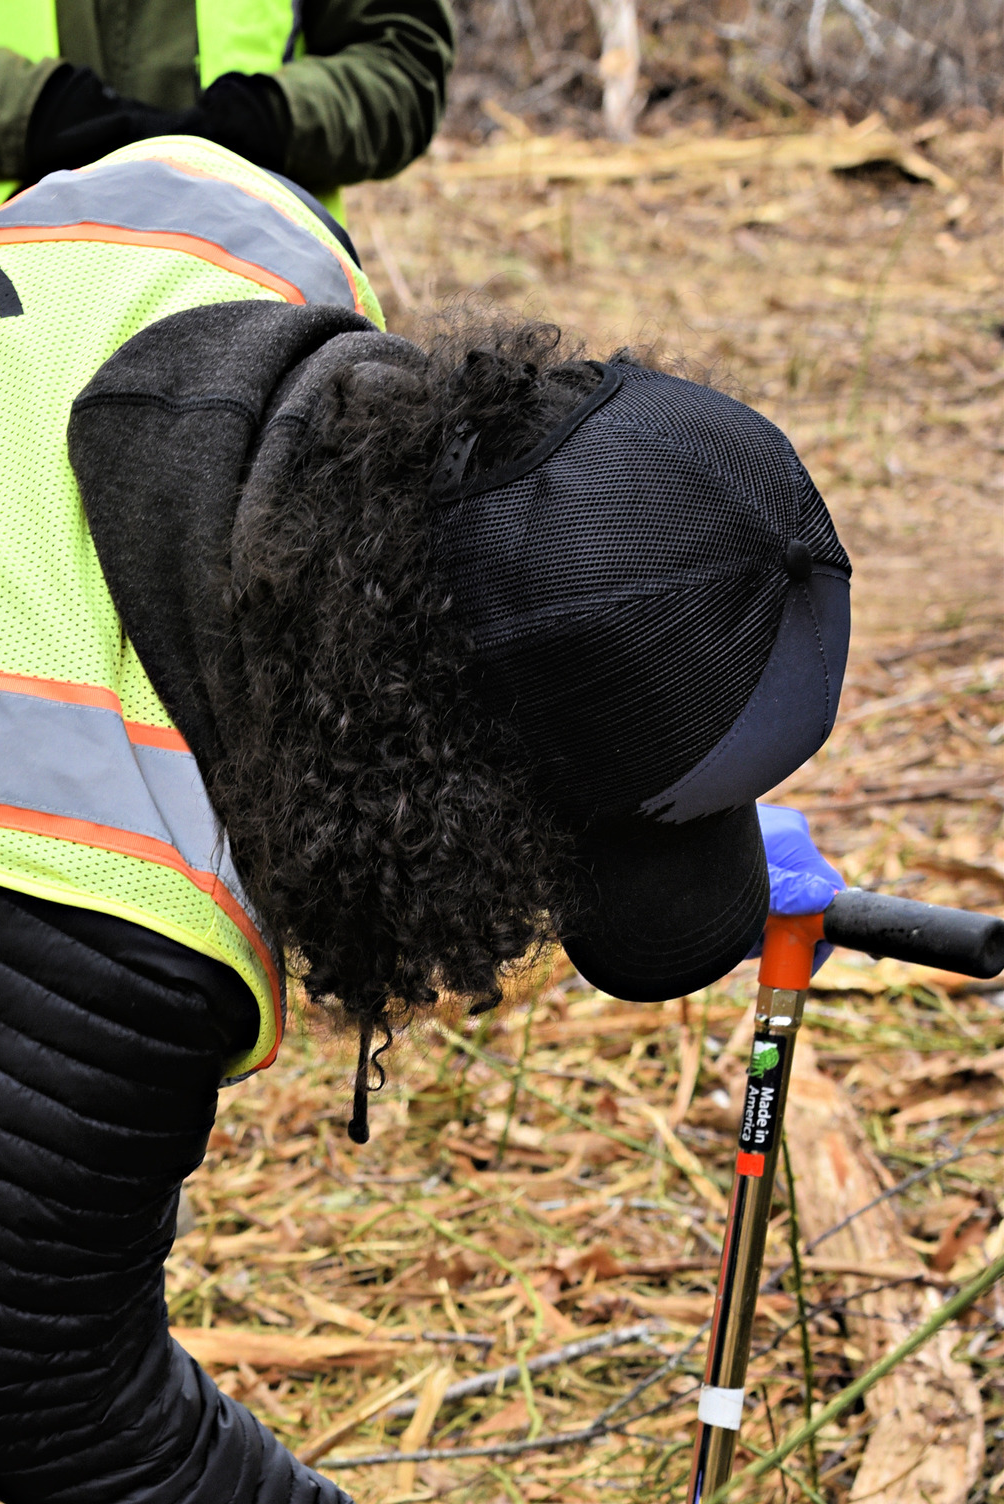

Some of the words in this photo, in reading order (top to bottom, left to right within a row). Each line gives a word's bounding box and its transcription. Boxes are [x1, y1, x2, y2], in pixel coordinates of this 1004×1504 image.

[742, 1085, 759, 1141] America
[756, 1086, 775, 1128] Made
[754, 1129, 769, 1143] in
